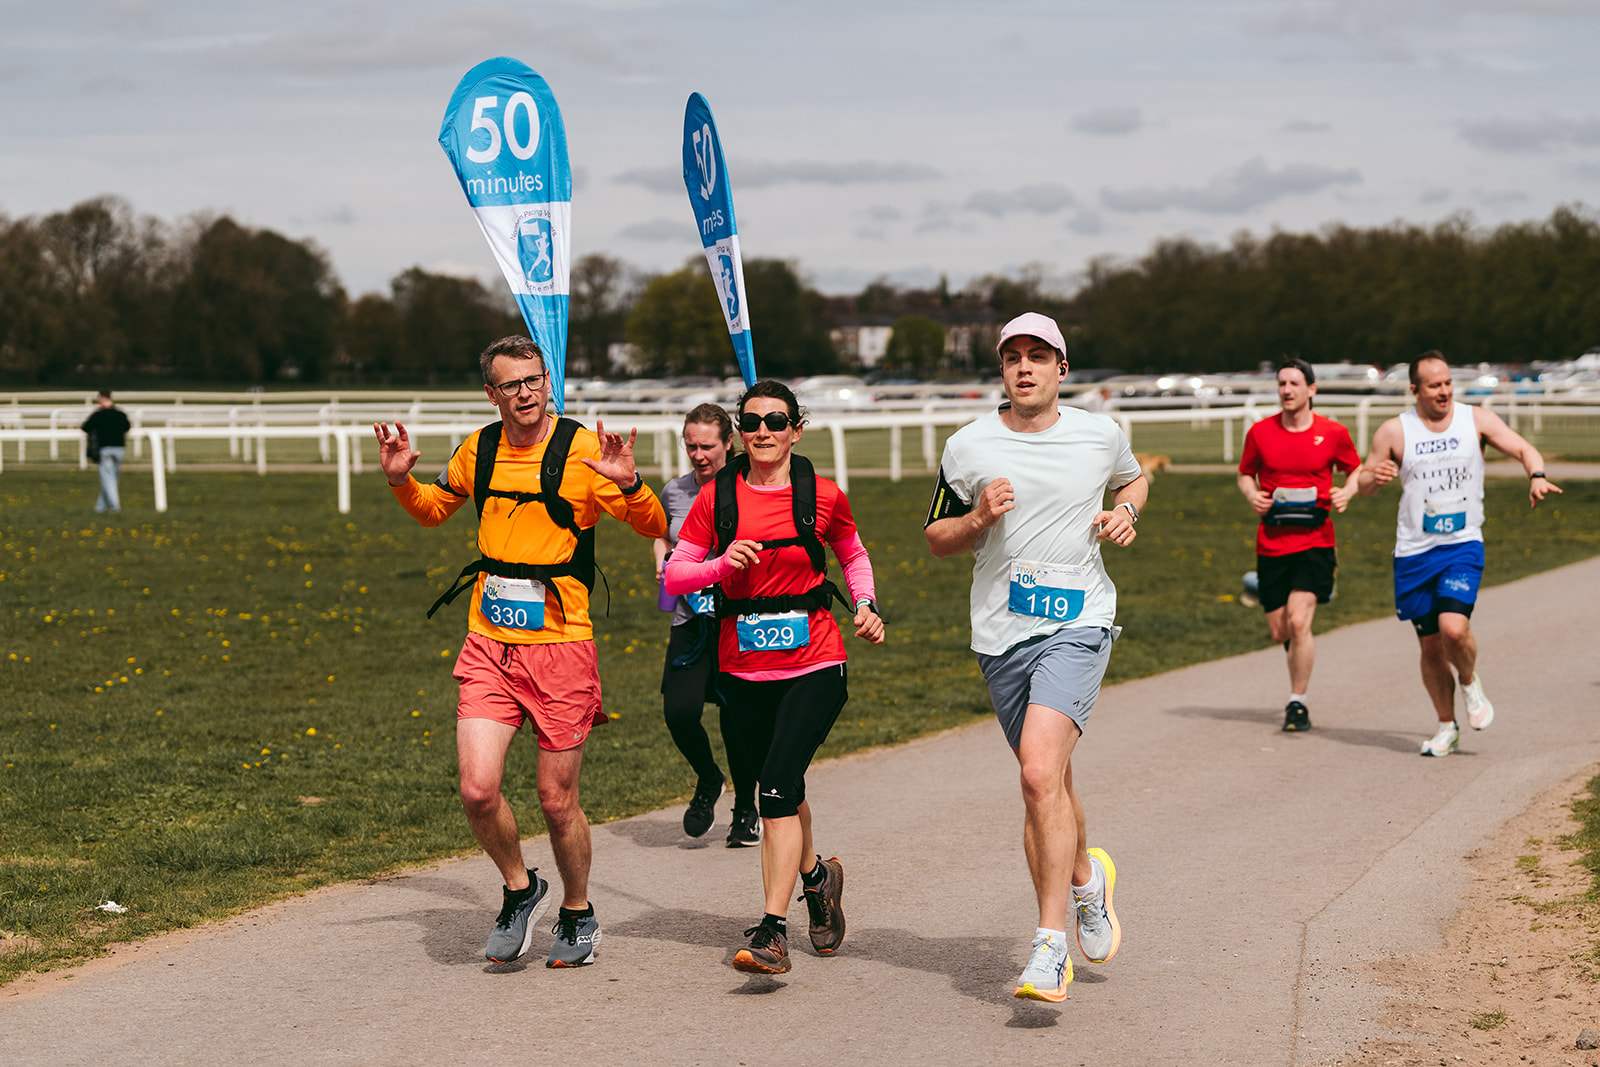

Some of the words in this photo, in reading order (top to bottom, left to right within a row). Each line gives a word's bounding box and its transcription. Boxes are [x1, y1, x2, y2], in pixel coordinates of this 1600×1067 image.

[465, 91, 541, 164] 50
[692, 122, 717, 201] 50
[466, 170, 544, 195] minutes
[1416, 439, 1446, 454] NHS
[1434, 517, 1454, 533] 45
[1016, 573, 1036, 585] 10k
[490, 604, 528, 627] 330
[1026, 593, 1069, 618] 119
[753, 626, 795, 648] 329
